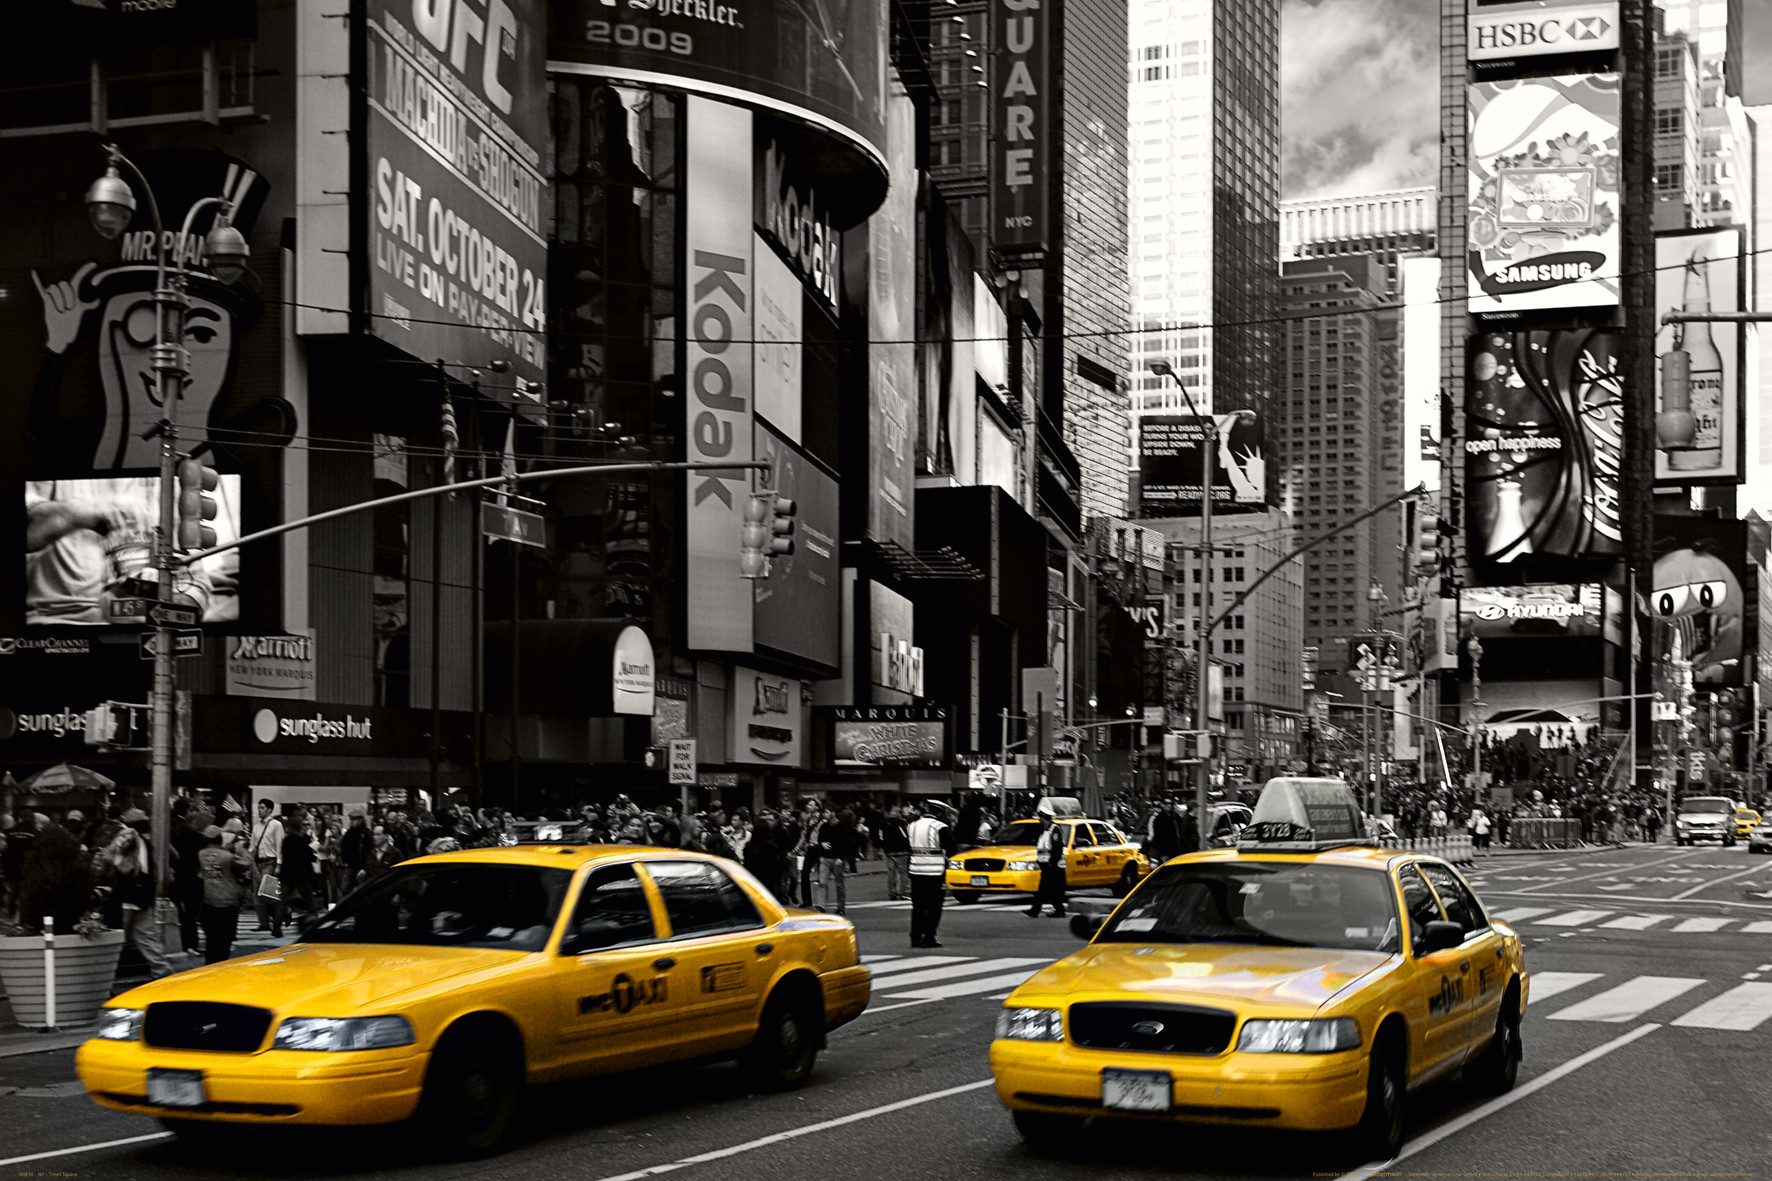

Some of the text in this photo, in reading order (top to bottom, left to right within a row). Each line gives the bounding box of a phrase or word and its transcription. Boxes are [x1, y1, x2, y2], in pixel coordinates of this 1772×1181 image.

[586, 20, 693, 55] 2009
[1475, 20, 1561, 49] HSBC
[1003, 0, 1040, 186] UARE
[385, 43, 468, 176] MACHIDA
[478, 131, 540, 234] SHOGUN
[765, 138, 837, 308] Kodak
[1005, 215, 1033, 228] NYC
[120, 231, 157, 261] MR.
[377, 157, 424, 253] SAT.
[428, 197, 519, 318] OCTOBER
[522, 268, 546, 333] 24
[1495, 262, 1592, 284] SAMSUNG
[377, 232, 415, 289] LIVE
[420, 262, 445, 308] ON
[449, 282, 545, 370] PAY-PER-VIEW
[694, 249, 746, 511] Kodak
[1466, 435, 1562, 452] open happiness
[176, 613, 194, 624] WAY
[1507, 603, 1584, 618] HYUNDAI
[233, 636, 312, 660] Marriott
[18, 706, 88, 738] sunglas
[280, 713, 372, 743] sunglass hut
[835, 708, 946, 719] MARQUIS
[868, 723, 918, 740] WHITE
